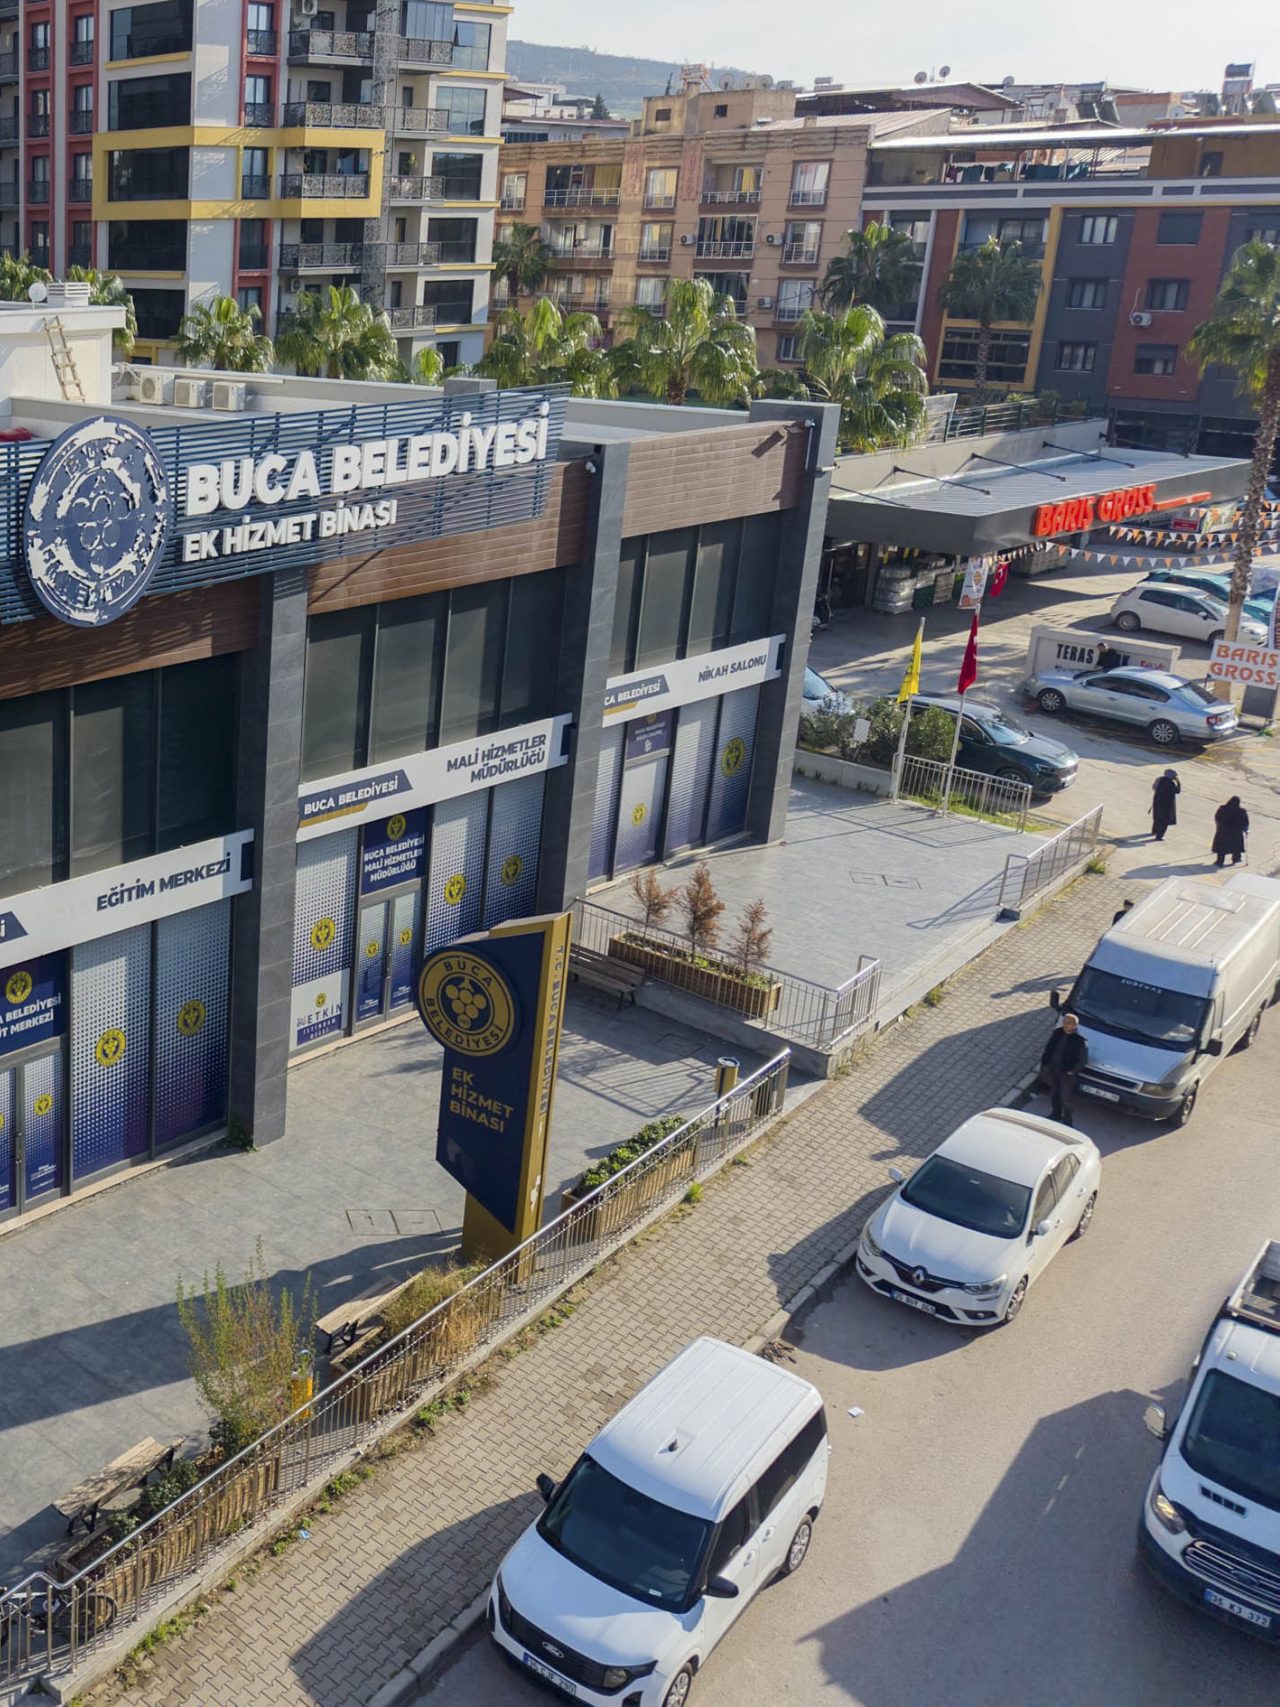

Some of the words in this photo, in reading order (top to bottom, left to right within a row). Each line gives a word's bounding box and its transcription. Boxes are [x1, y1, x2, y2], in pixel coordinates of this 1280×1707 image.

[185, 450, 321, 517] BUCA
[331, 401, 551, 494] BELEDİYESİ
[1098, 483, 1157, 522] GROSS
[183, 531, 220, 562] EK
[222, 514, 317, 555] HİZMET
[320, 500, 398, 538] BİNASI
[698, 666, 728, 683] NİKAH
[730, 655, 767, 674] SALONU
[1056, 643, 1094, 664] TERAS
[1210, 662, 1277, 685] GROSS
[604, 695, 616, 706] CA
[617, 679, 661, 702] BELEDİYESİ
[447, 747, 479, 772] MALİ
[481, 734, 547, 762] HİZMETLER
[471, 748, 545, 783] MÜDÜRLÜĞÜ
[304, 797, 335, 814] BUCA
[338, 775, 399, 805] BELEDİYESİ
[364, 849, 384, 861] BUCA
[96, 876, 155, 911] EĞİTİM
[159, 852, 231, 891] MERKEZİ
[443, 960, 492, 987] BUCA
[5, 992, 61, 1022] BELEDİYESİ
[10, 1008, 54, 1035] MERKEZİ
[452, 1067, 474, 1086] EK
[449, 1100, 505, 1133] BİNASI
[451, 1083, 514, 1119] HİZMET
